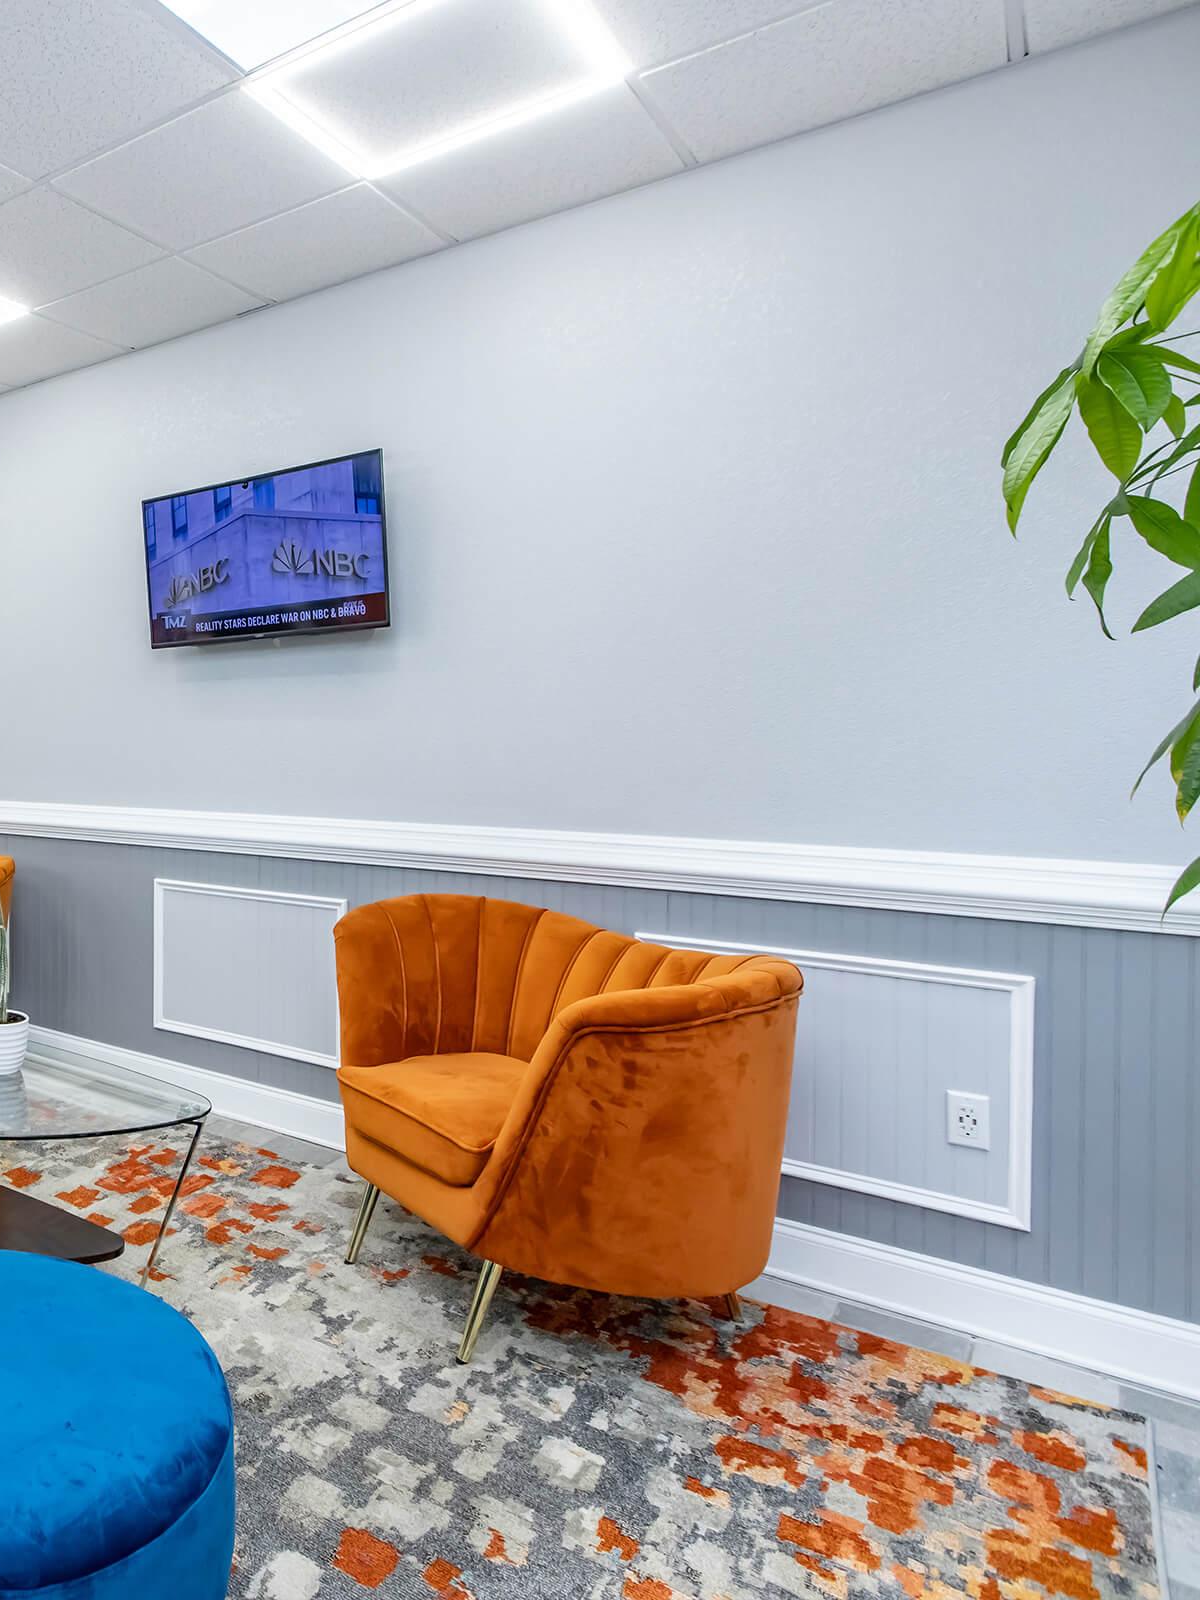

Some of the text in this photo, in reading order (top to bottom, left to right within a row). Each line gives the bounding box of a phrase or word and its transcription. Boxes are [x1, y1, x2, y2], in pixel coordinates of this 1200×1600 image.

[187, 557, 230, 597] NBC
[314, 549, 371, 579] NBC
[161, 615, 187, 629] TMZ
[195, 604, 366, 632] REALITY STARS DECLARE WAR ON NBC & BRAVO
